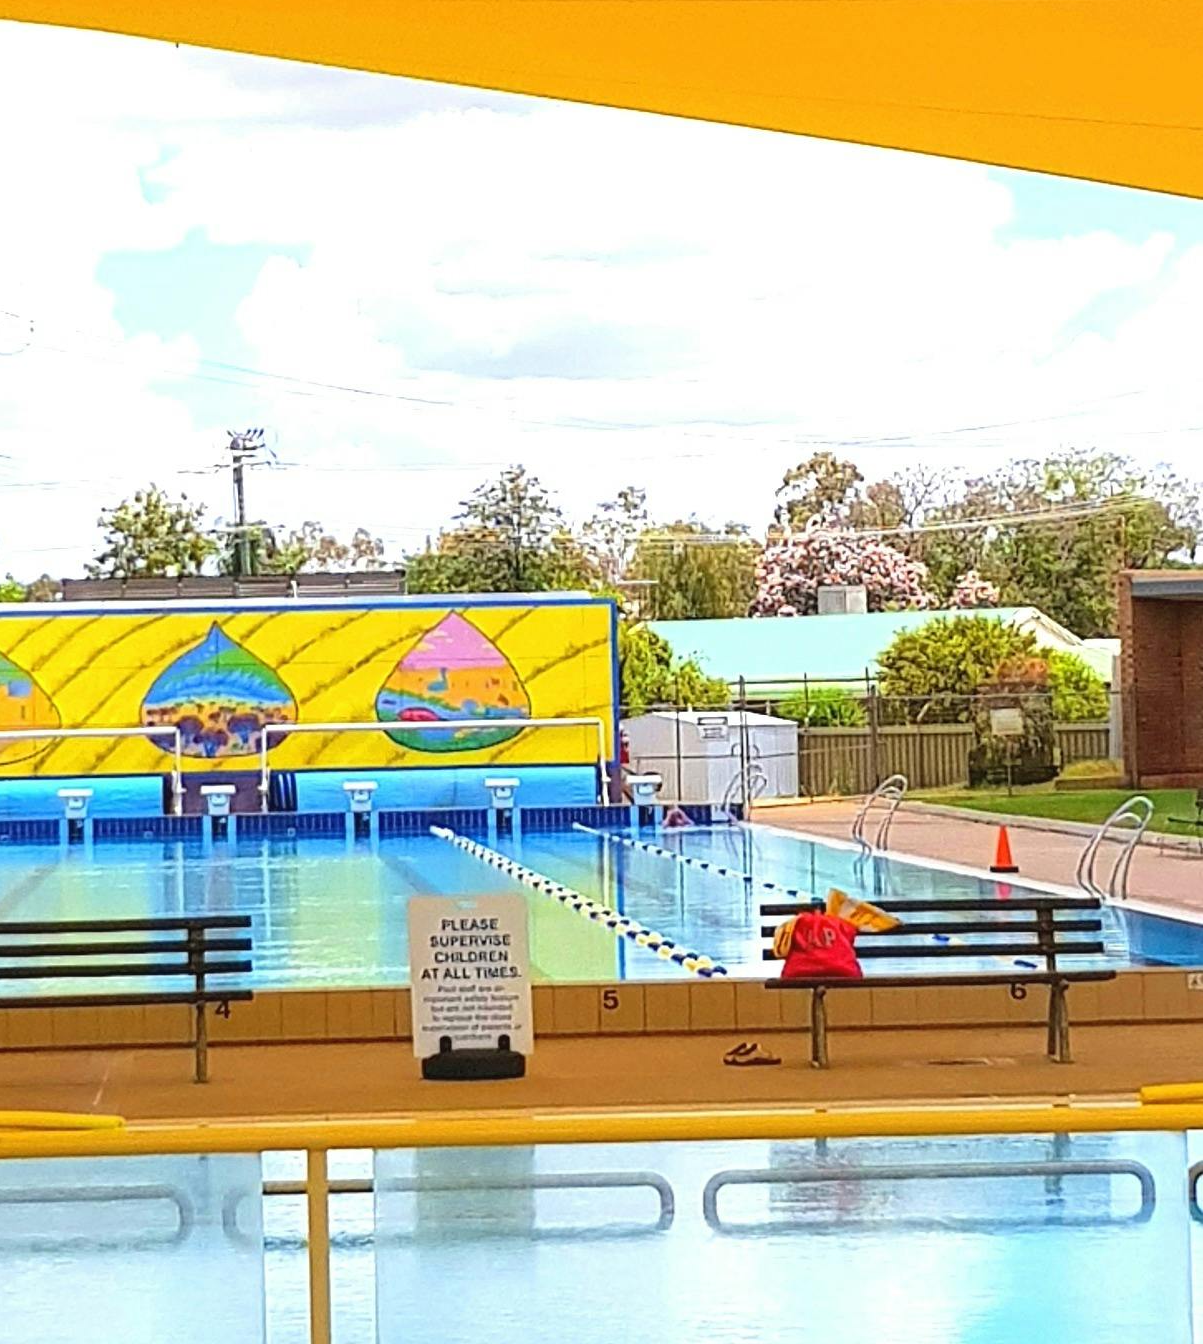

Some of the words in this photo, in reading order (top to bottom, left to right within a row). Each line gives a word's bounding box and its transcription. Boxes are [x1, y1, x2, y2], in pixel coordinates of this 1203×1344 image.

[441, 918, 499, 931] PLEASE
[430, 934, 511, 948] SUPERVISE
[434, 950, 509, 964] CHILDREN
[421, 967, 439, 980] AT
[443, 967, 471, 980] ALL
[476, 966, 522, 980] TIMES.
[1011, 982, 1027, 1000] 6
[603, 990, 619, 1010] 5
[215, 1000, 231, 1019] 4
